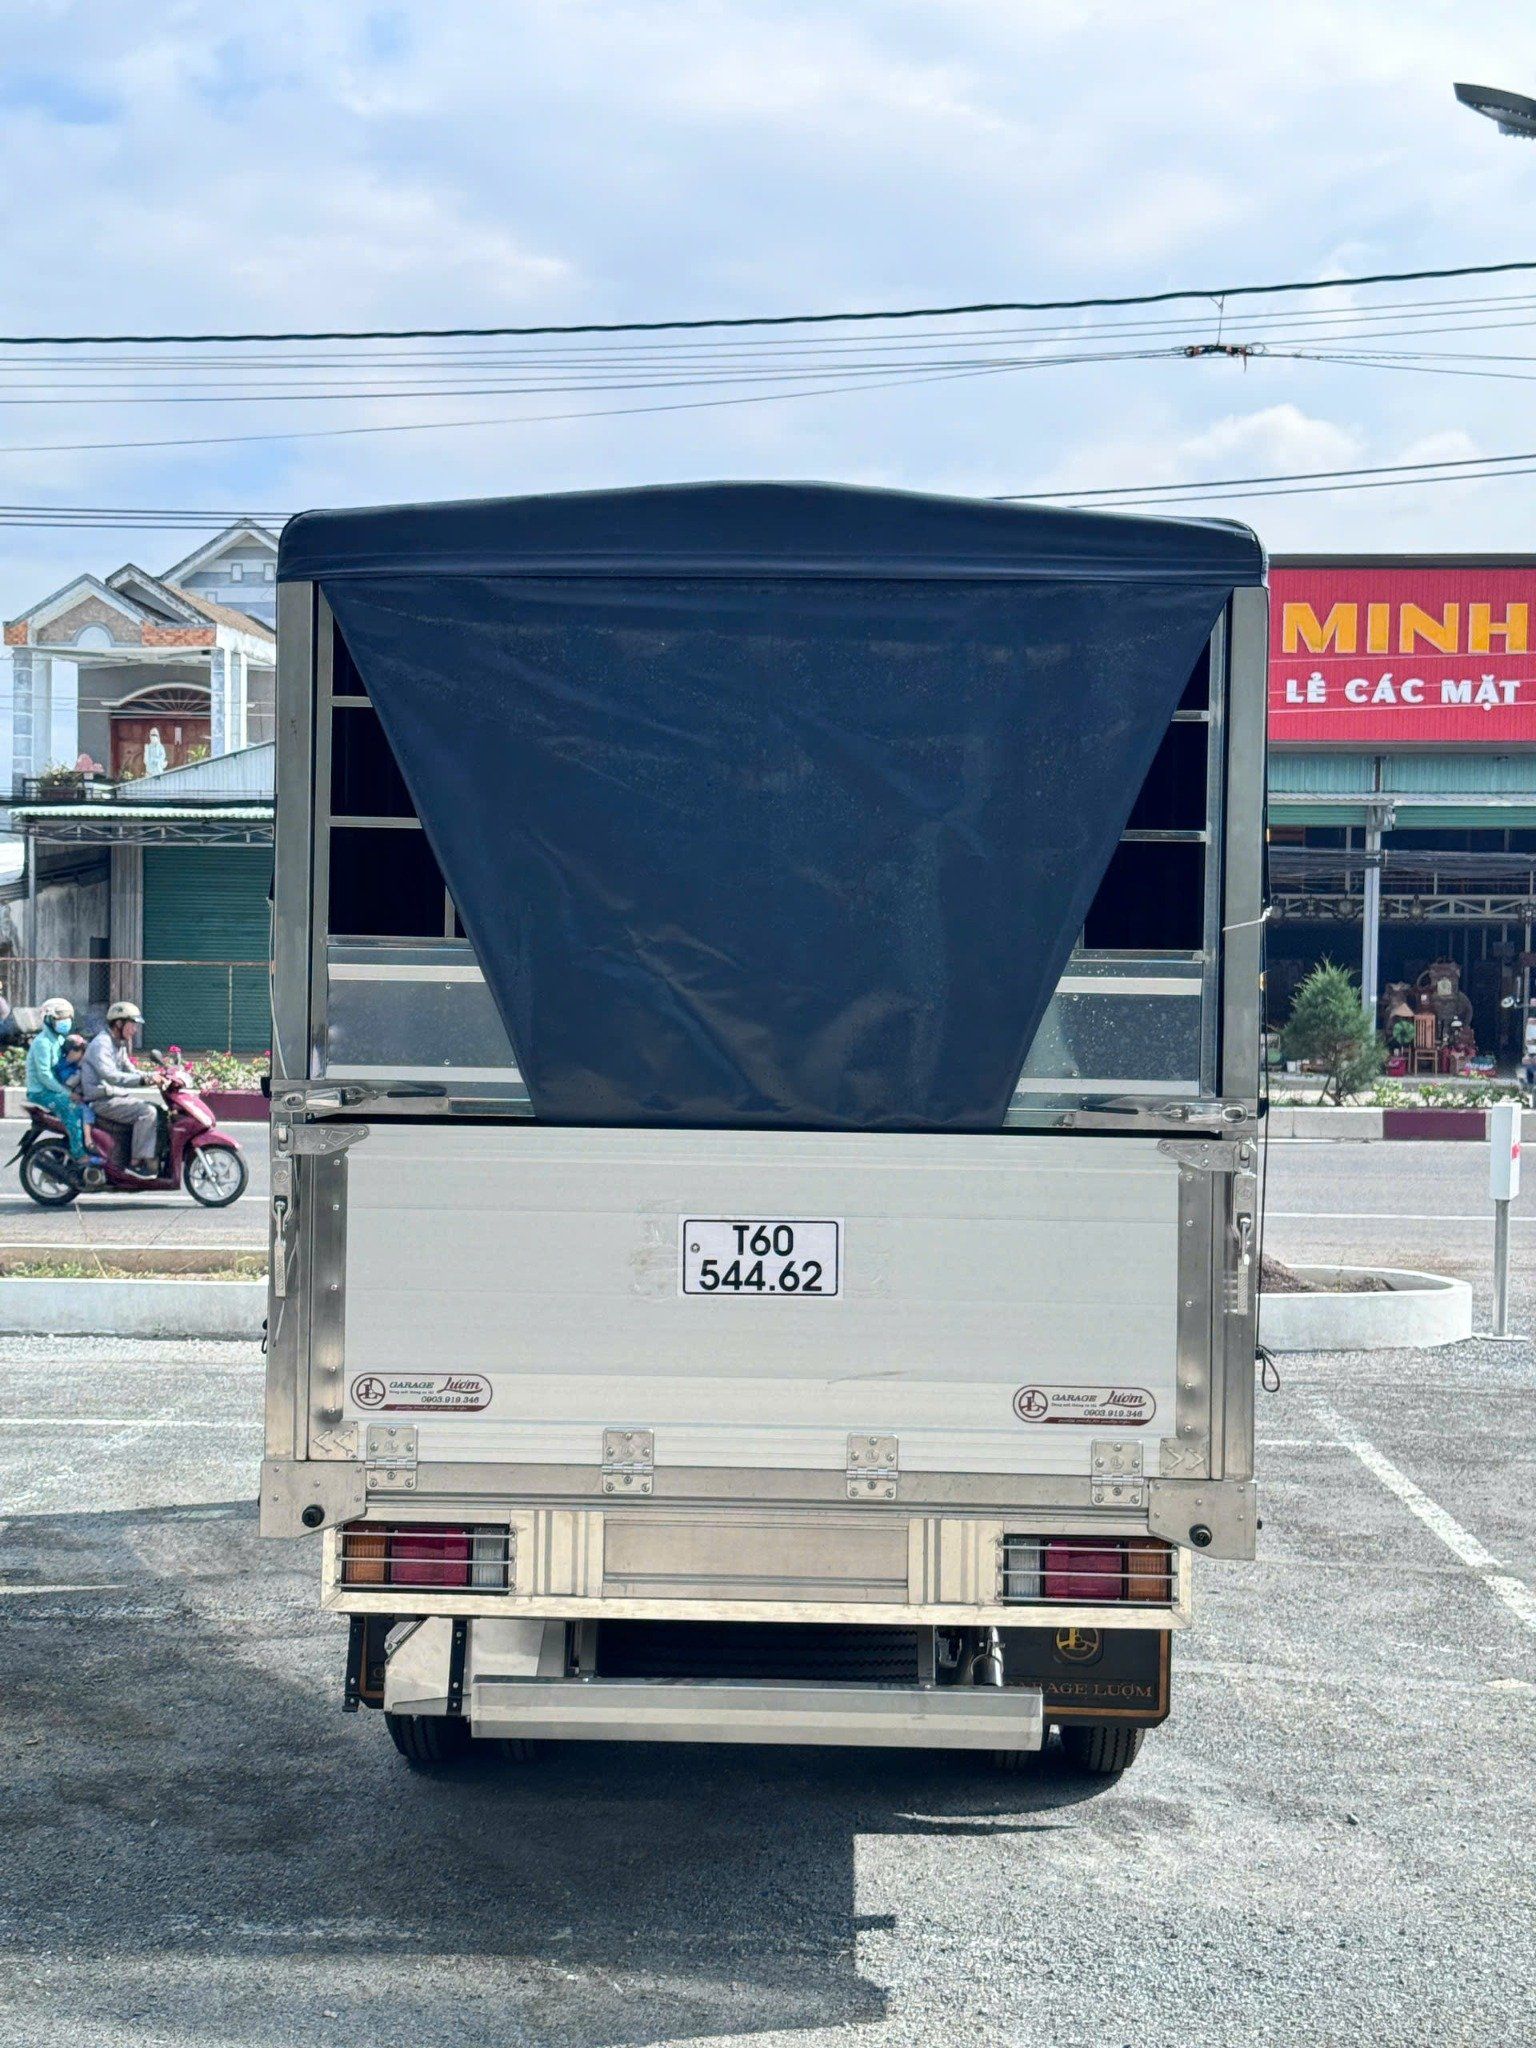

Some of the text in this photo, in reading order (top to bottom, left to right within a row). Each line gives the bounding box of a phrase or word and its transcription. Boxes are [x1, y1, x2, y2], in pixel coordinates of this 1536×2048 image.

[1282, 602, 1528, 654] MINH
[1344, 672, 1425, 704] CÁC
[1440, 674, 1521, 711] MẶT
[732, 1224, 794, 1257] T60
[699, 1259, 823, 1292] 544.62
[389, 1381, 435, 1389] GARAGE
[1051, 1394, 1098, 1402] GARAGE
